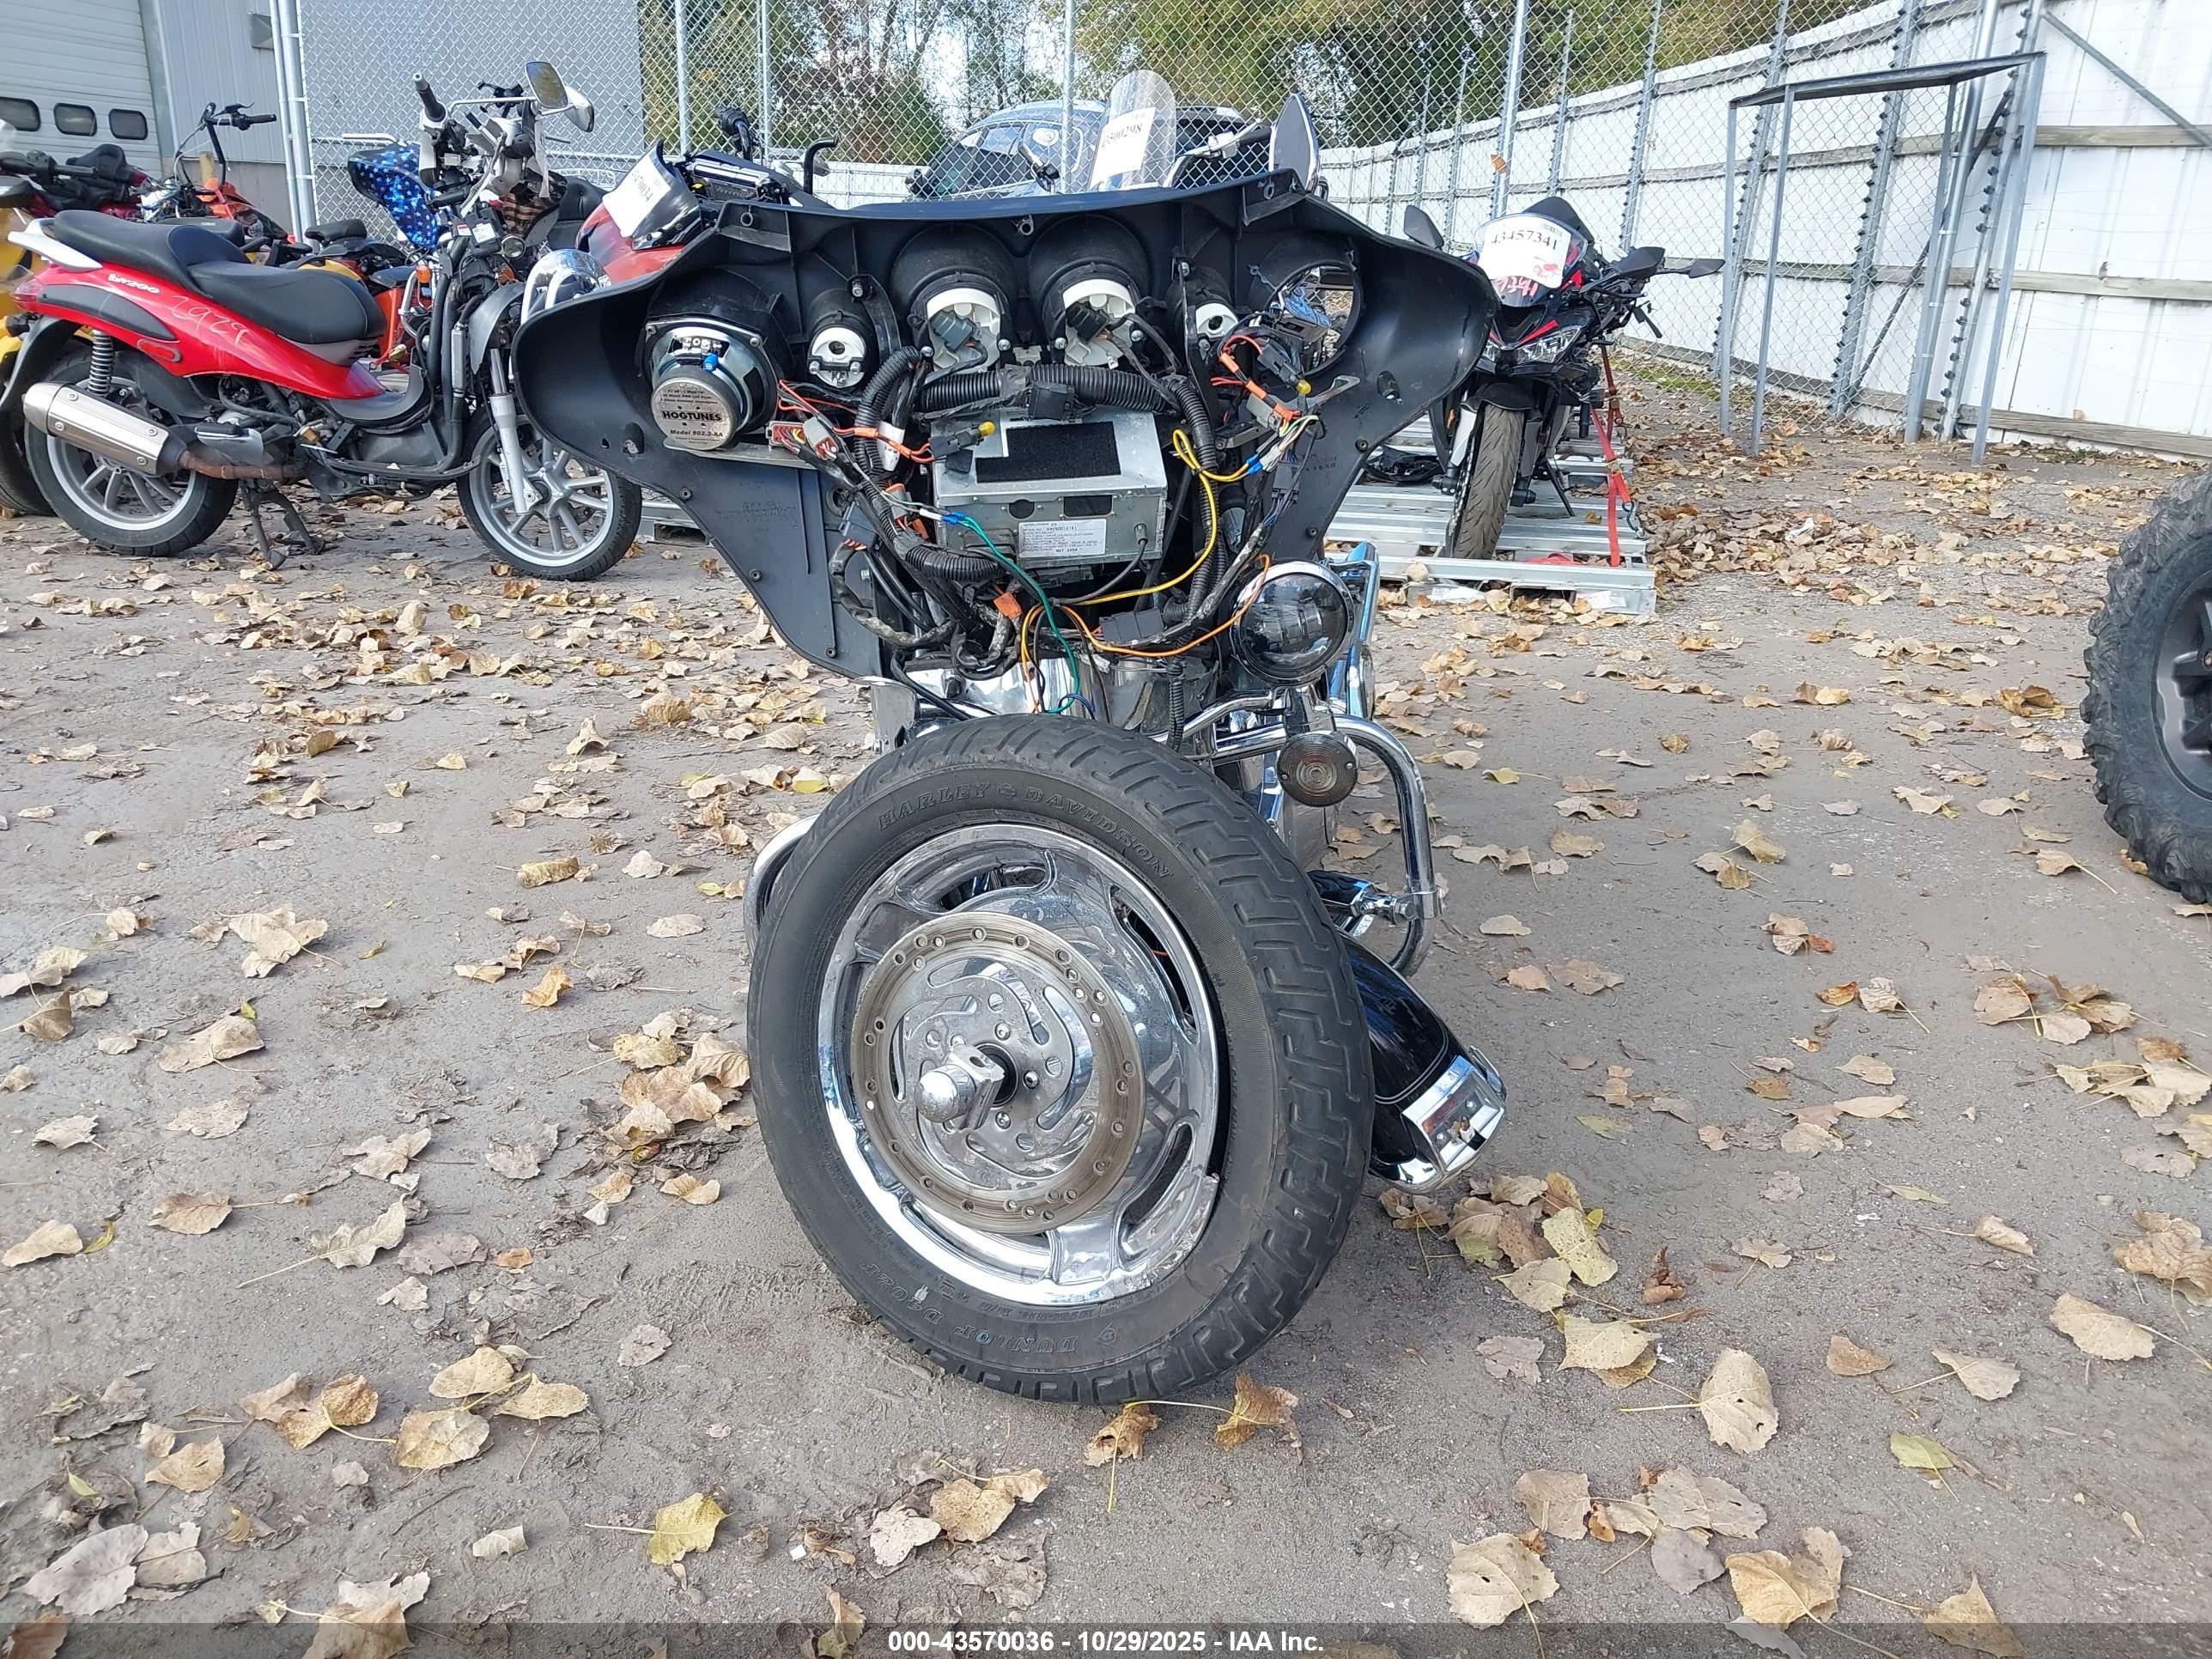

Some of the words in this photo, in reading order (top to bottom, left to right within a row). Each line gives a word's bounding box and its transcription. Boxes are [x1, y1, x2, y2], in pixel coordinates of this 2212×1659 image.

[1491, 229, 1558, 251] 43457341
[662, 410, 722, 421] HOGTUNES
[878, 782, 990, 830] HARLEY
[1023, 787, 1174, 879] DAVIDSON
[954, 1324, 1080, 1354] DUNLOP
